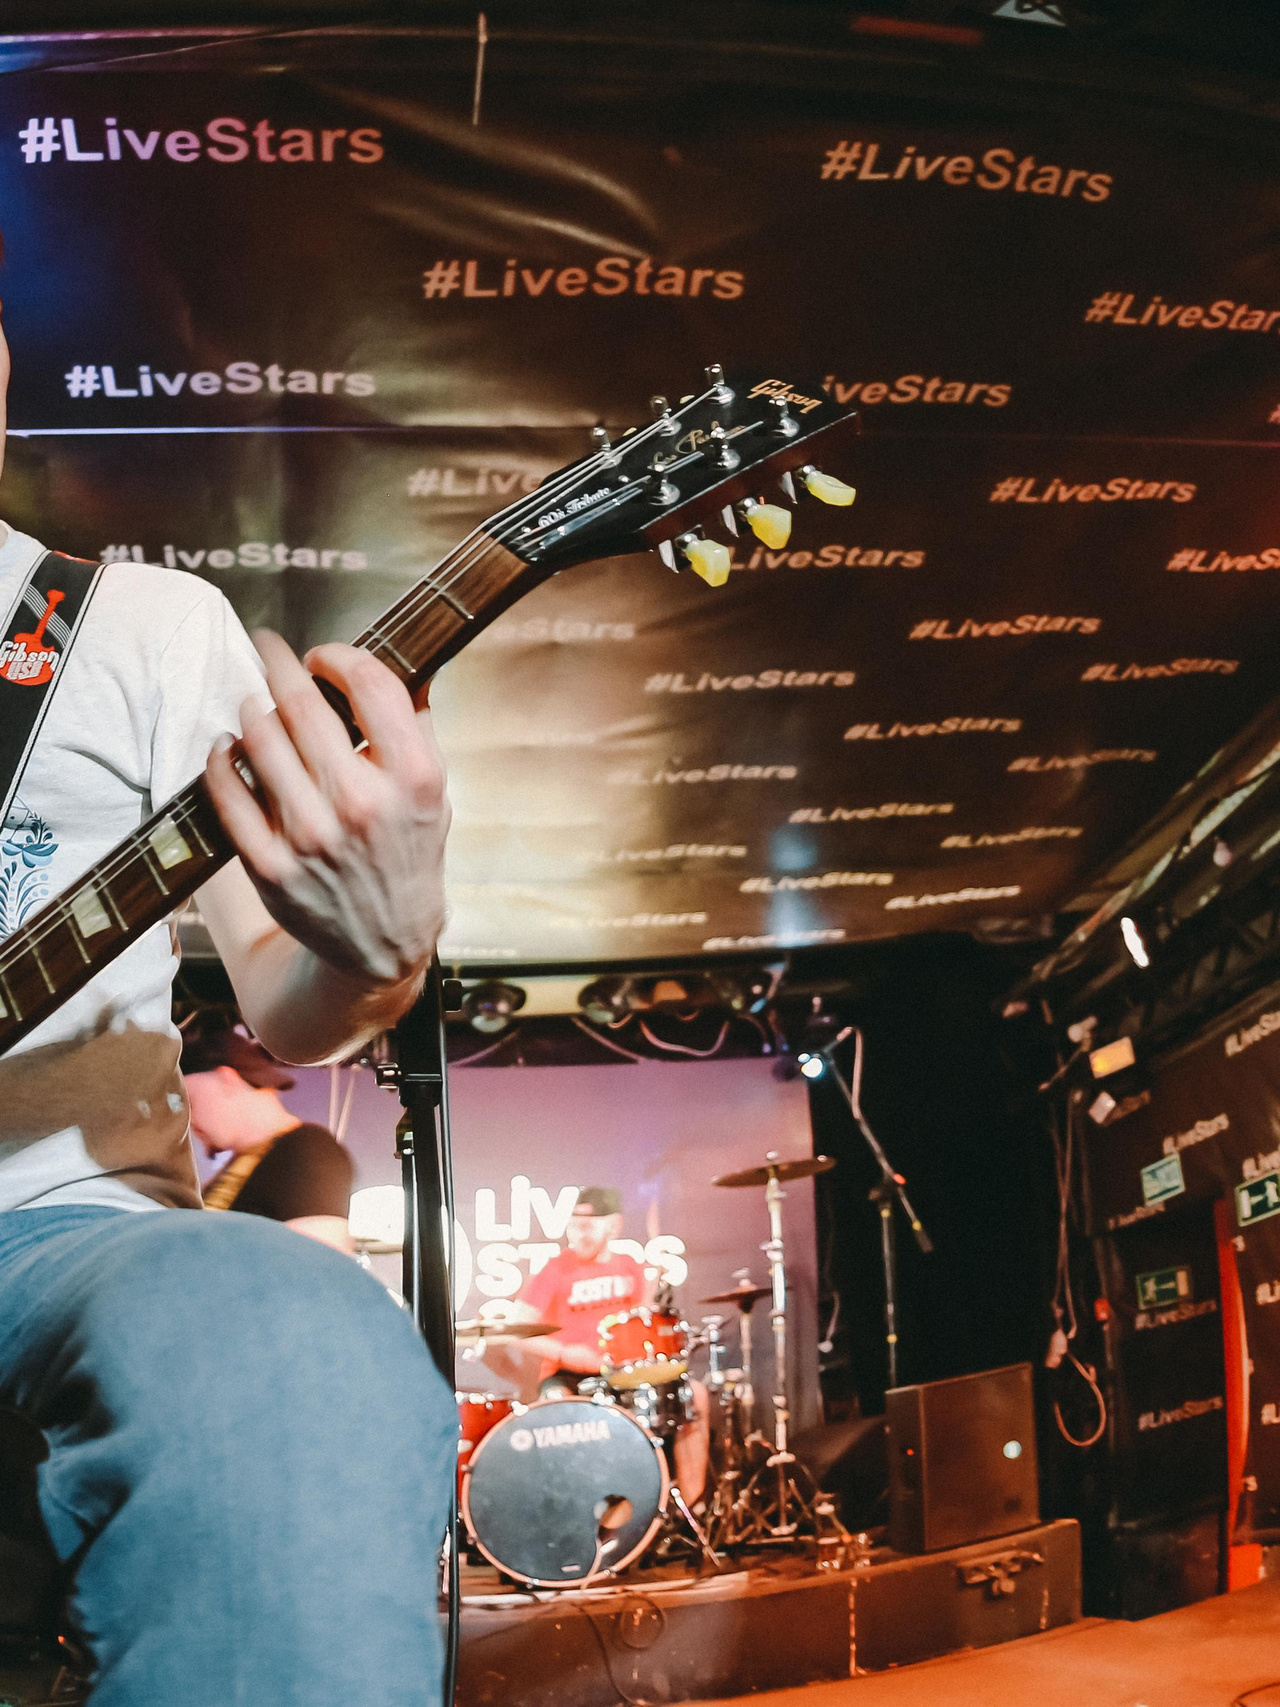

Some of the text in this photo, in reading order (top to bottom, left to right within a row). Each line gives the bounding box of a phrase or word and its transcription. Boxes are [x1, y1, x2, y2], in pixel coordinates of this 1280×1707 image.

[19, 116, 384, 164] #LiveStars
[821, 140, 1113, 202] #LiveStars
[423, 256, 745, 300] #LiveStars
[1085, 291, 1280, 334] #LiveStar
[65, 361, 377, 398] #LiveStars
[822, 374, 1011, 407] iveStars
[747, 378, 822, 414] Gibson
[407, 466, 541, 498] #Live
[990, 476, 1197, 503] #LiveStars
[730, 544, 926, 570] LiveStars
[1167, 548, 1280, 573] #LiveS
[491, 616, 636, 642] eStars
[909, 614, 1102, 640] #LiveStars
[643, 669, 856, 694] #LiveStars
[1080, 657, 1240, 682] #LiveStars
[843, 717, 1022, 740] #LiveStars
[789, 803, 955, 824] #LiveStars
[602, 844, 747, 863] iveStars
[740, 872, 894, 893] #LiveStars
[475, 1235, 688, 1297] STS
[532, 1420, 611, 1448] YAMAHA
